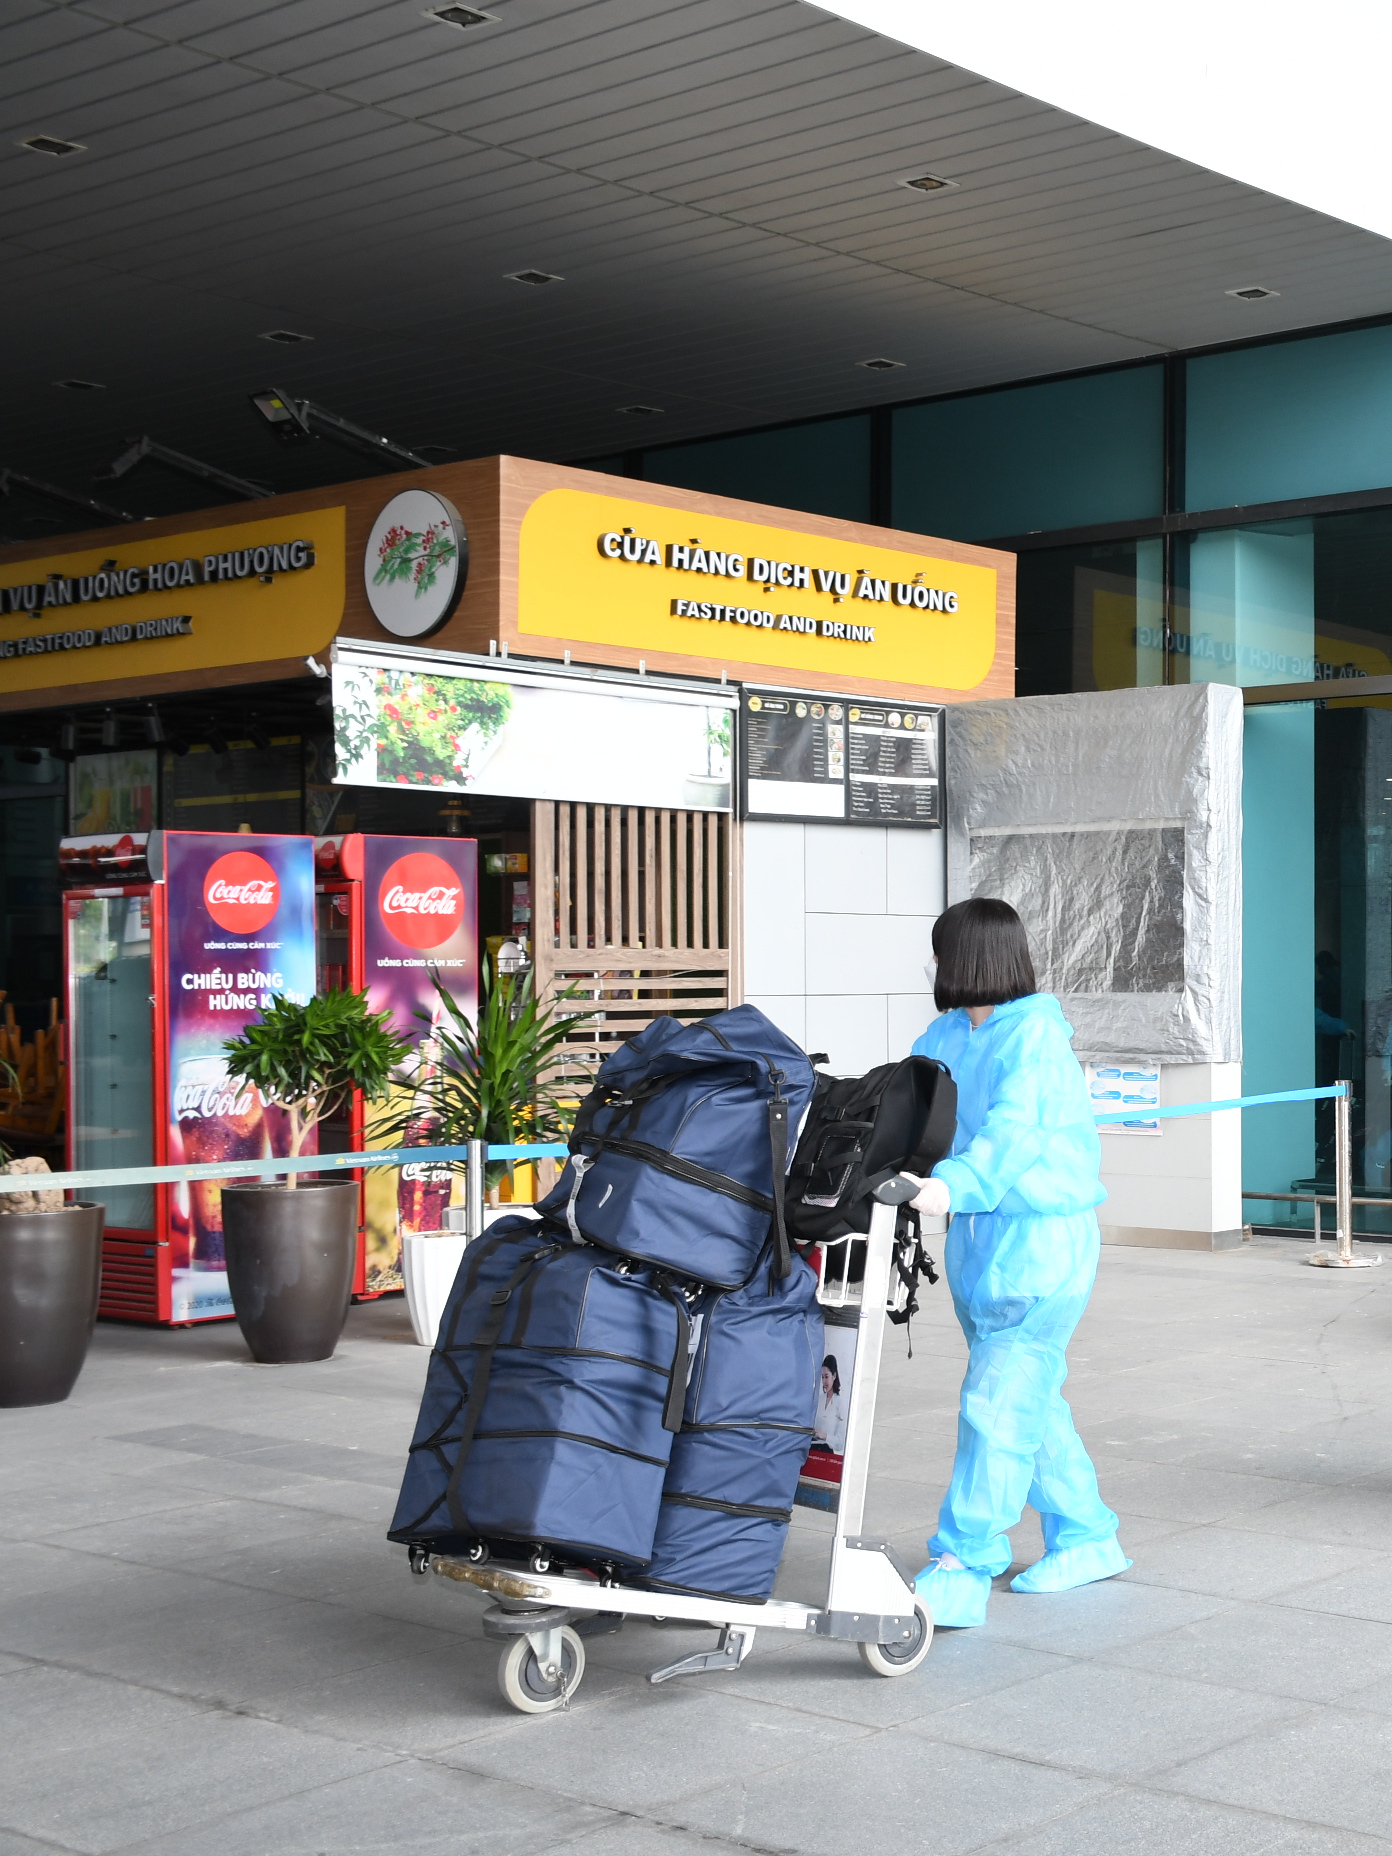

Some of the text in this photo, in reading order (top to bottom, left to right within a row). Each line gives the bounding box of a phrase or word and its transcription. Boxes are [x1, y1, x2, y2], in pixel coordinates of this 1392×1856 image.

[147, 558, 196, 590] HOA
[203, 539, 315, 583] PHƯỢNG
[598, 527, 662, 565] CỬA
[666, 538, 745, 578] HÀNG
[747, 557, 810, 593] DỊCH
[813, 568, 851, 604] VỤ
[892, 572, 959, 613] UỐNG
[17, 629, 96, 655] FASTFOOD
[101, 624, 132, 644] AND
[136, 616, 190, 639] DRINK
[671, 599, 876, 642] FASTFOOD AND DRINK
[237, 969, 284, 989] BỪNG
[209, 990, 257, 1010] HỨNG
